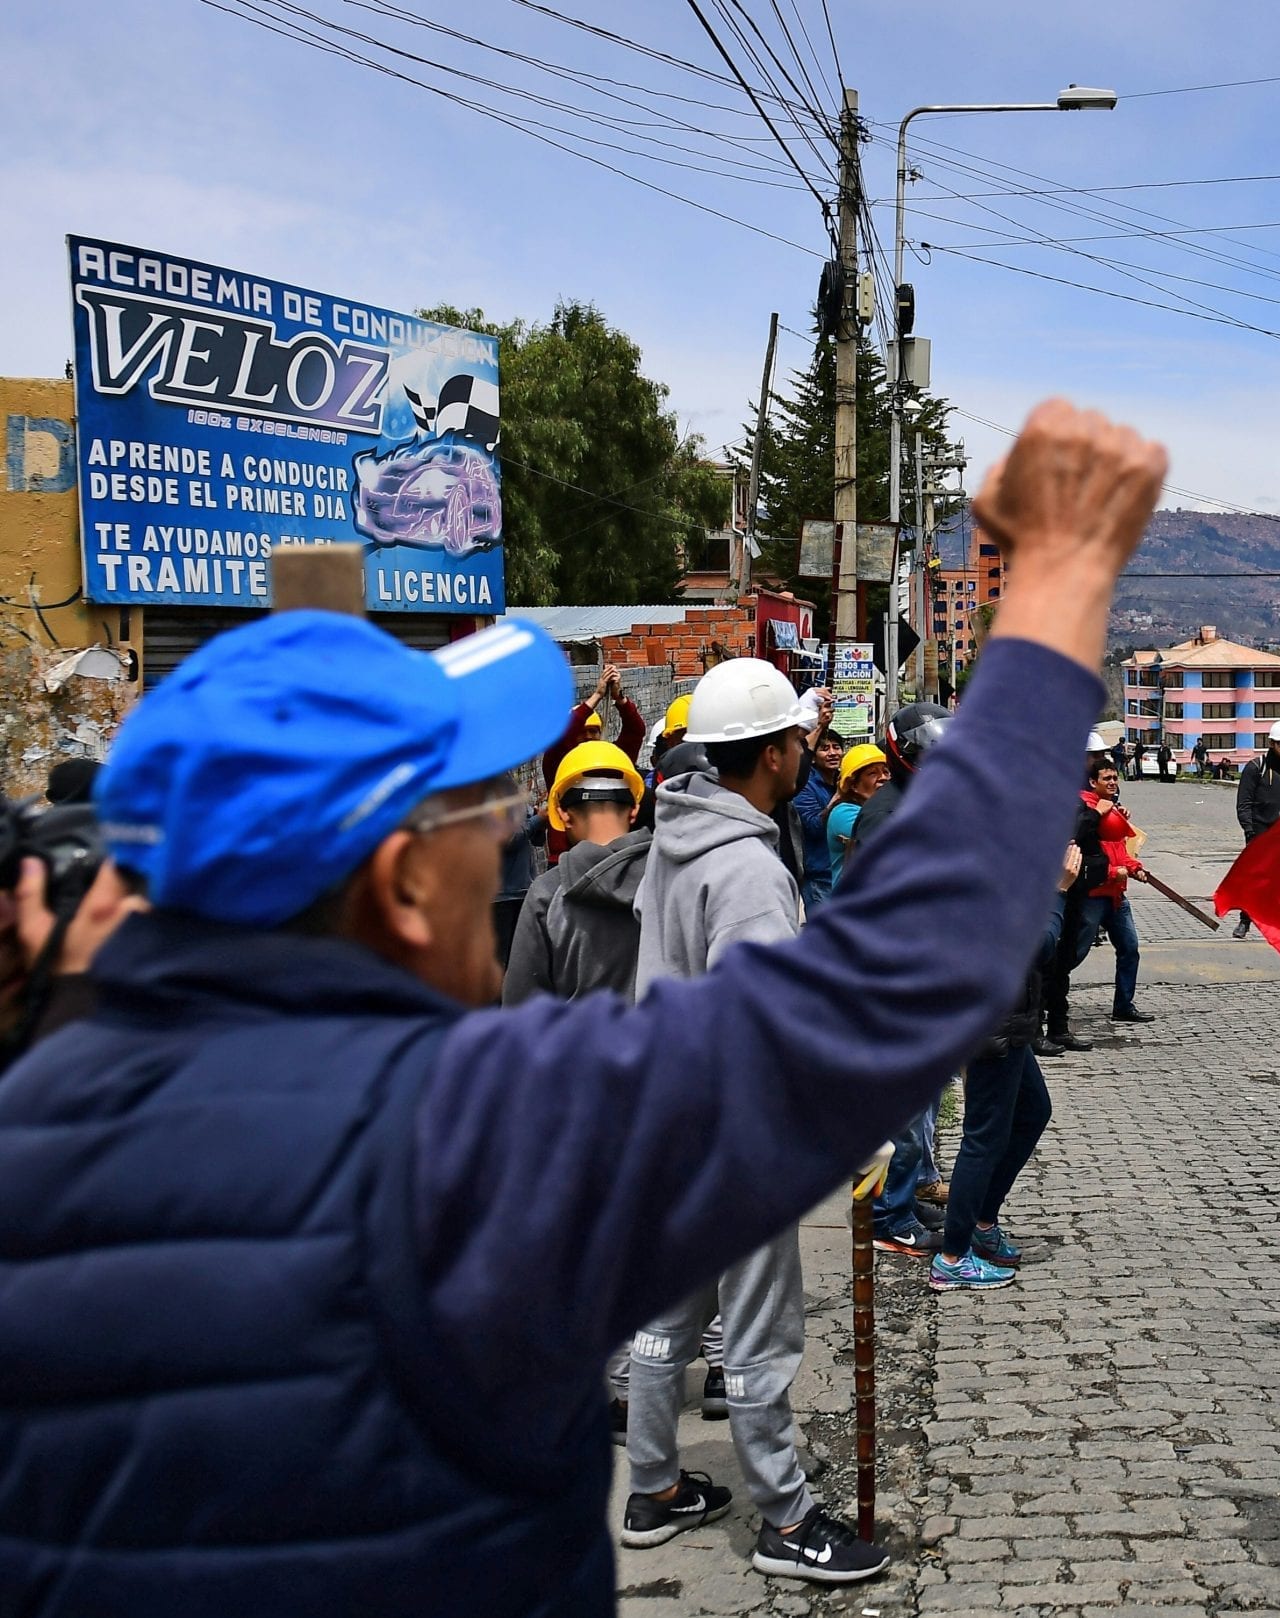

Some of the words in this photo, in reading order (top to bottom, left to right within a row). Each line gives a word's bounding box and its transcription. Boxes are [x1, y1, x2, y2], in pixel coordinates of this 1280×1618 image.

[79, 245, 272, 315] ACADEMIA
[283, 290, 322, 327] DE
[99, 303, 384, 422] VELOZ
[188, 409, 231, 428] 100%
[88, 439, 211, 476] APRENDE
[220, 453, 235, 479] A
[243, 456, 349, 492] CONDUCIR
[90, 472, 179, 505] DESDE
[189, 481, 217, 508] EL
[226, 485, 307, 517] PRIMER
[313, 496, 347, 521] DIA
[95, 523, 131, 550] TE
[142, 526, 273, 559] AYUDAMOS
[97, 554, 267, 596] TRAMITE
[378, 569, 492, 605] LICENCIA
